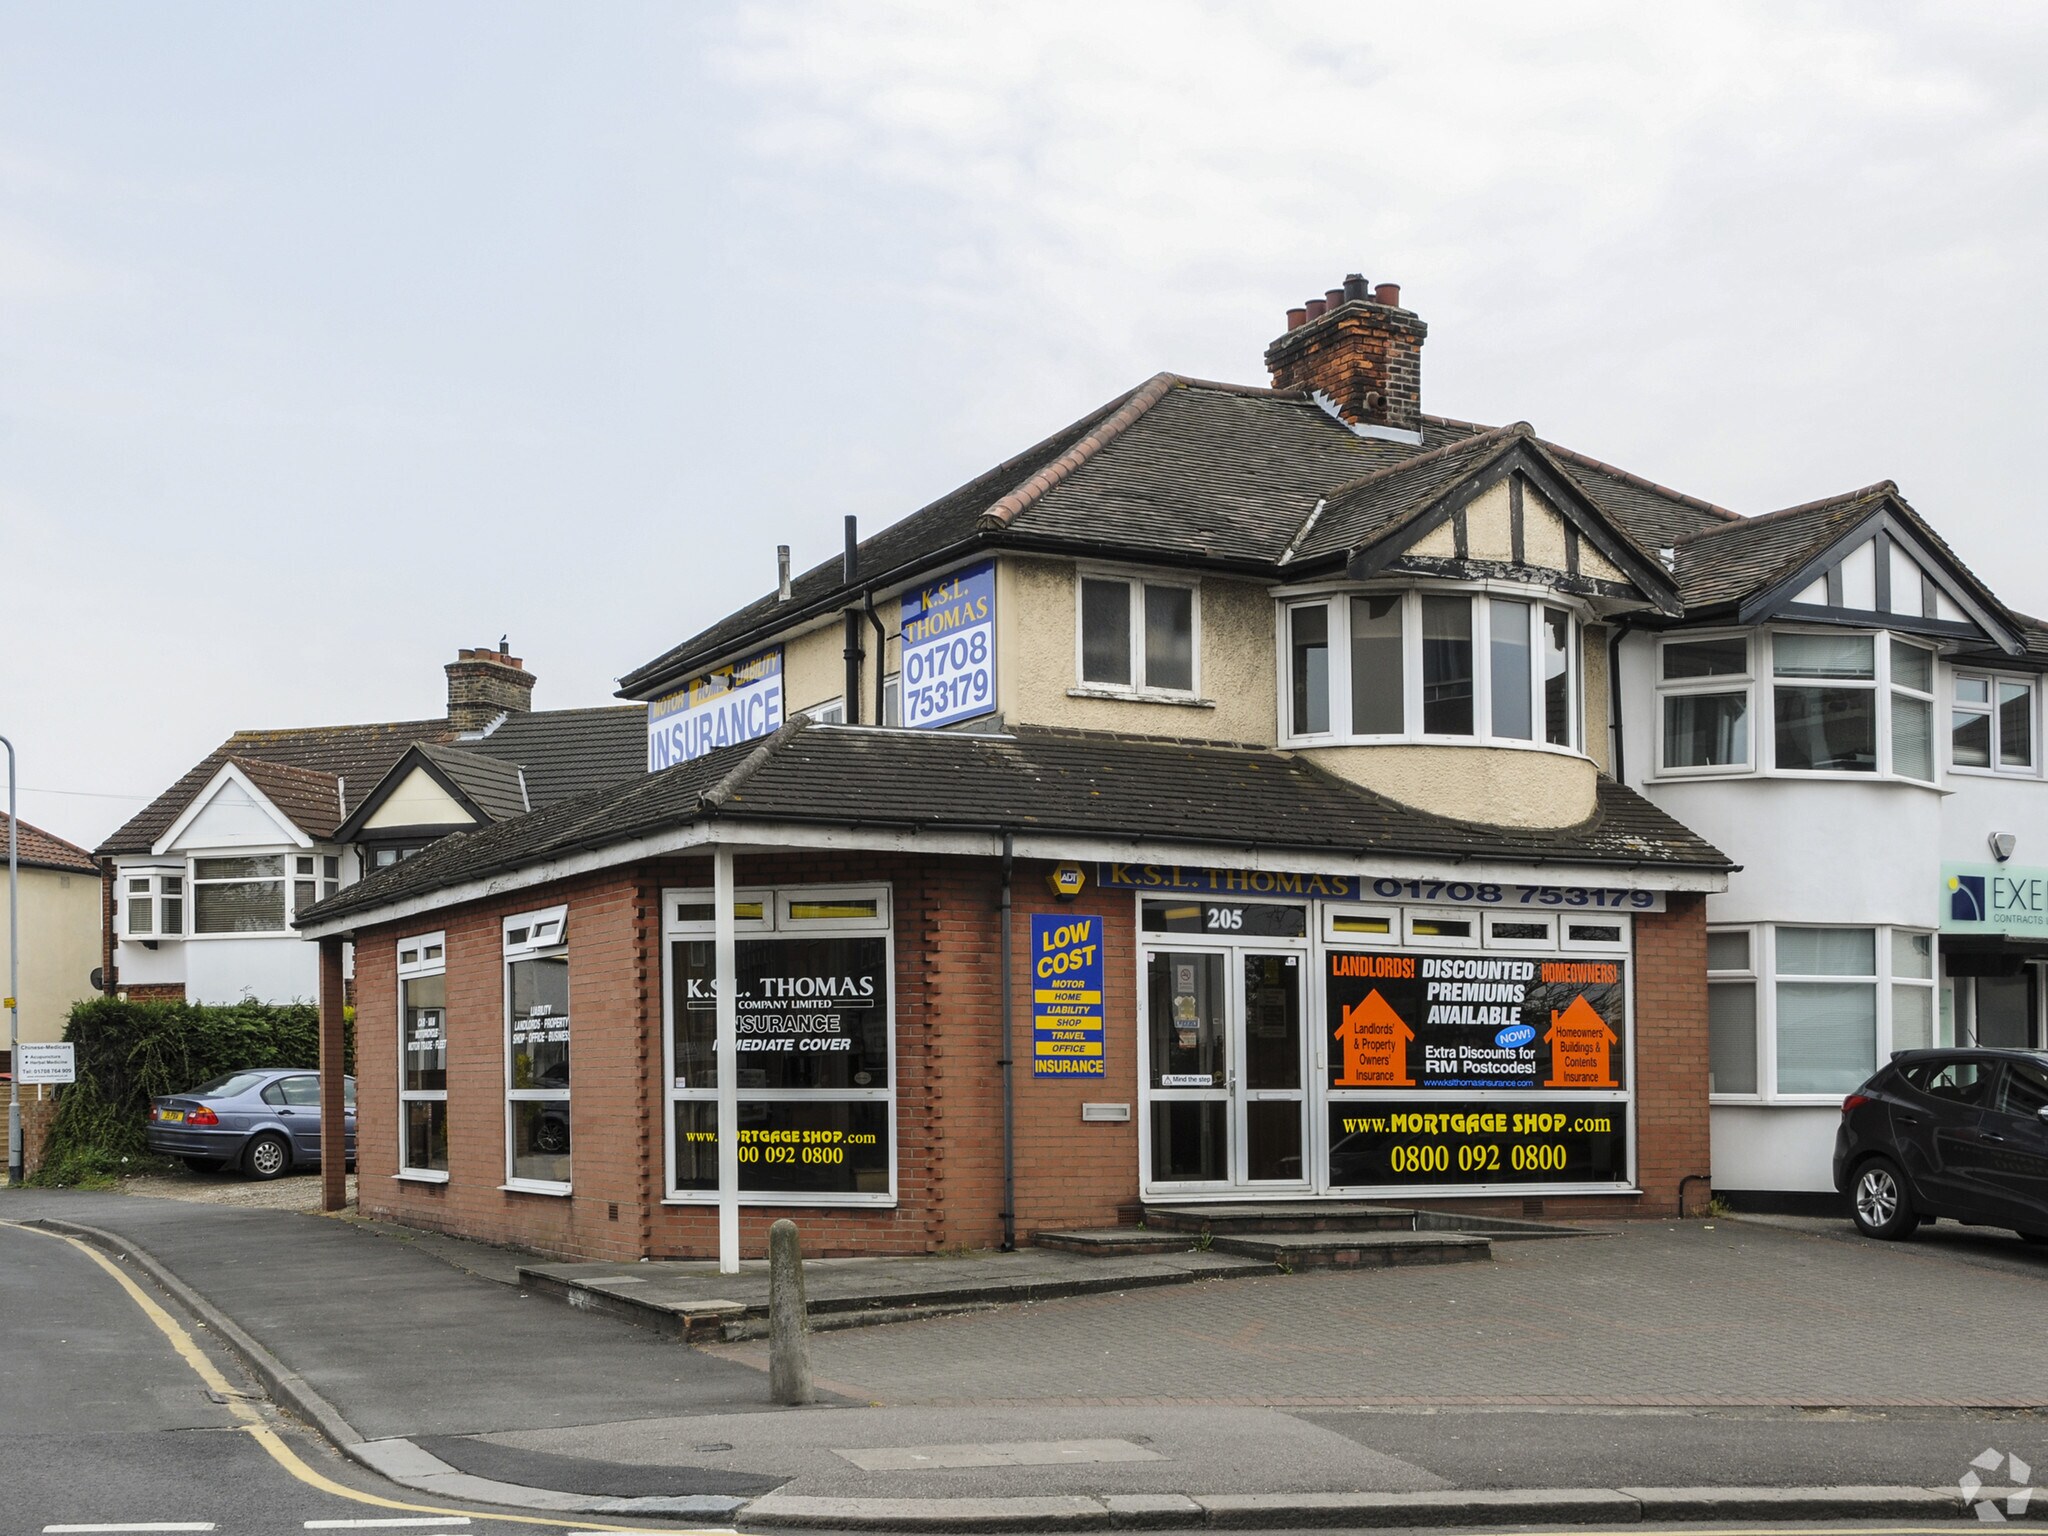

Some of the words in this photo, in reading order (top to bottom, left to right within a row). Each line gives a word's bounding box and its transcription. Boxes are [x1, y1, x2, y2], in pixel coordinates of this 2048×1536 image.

[922, 578, 969, 611] K.S.L.
[905, 596, 988, 644] THOMAS
[907, 630, 987, 685] 01708
[652, 690, 685, 718] MOTOR
[735, 650, 778, 687] LIABILITY
[907, 668, 989, 721] 753179
[650, 686, 780, 771] INSURANCE
[1061, 872, 1078, 882] ADT
[1112, 863, 1198, 889] K.S.L.
[1202, 868, 1350, 896] THOMAS
[1372, 877, 1503, 904] 01708
[1515, 885, 1654, 909] 753179
[1993, 877, 2048, 911] EXE
[1207, 907, 1244, 930] 205
[1993, 913, 2044, 925] CONTRACTS
[1043, 920, 1091, 952] LOW
[1037, 944, 1096, 978] COST
[1333, 955, 1415, 978] LANDLORDS!
[1422, 959, 1535, 980] DISCOUNTED
[1541, 963, 1617, 984] HOMEOWNERS!
[759, 976, 874, 997] THOMAS
[1052, 979, 1085, 988] MOTOR
[1054, 993, 1082, 1001] HOME
[1427, 982, 1526, 1003] PREMIUMS
[738, 1000, 788, 1010] COMPANY
[791, 1000, 832, 1009] LIMITED
[1047, 1006, 1090, 1014] LIABILITY
[1427, 1005, 1522, 1025] AVAILABLE
[1056, 1019, 1082, 1027] SHOP
[1354, 1022, 1395, 1035] Landlords'
[1052, 1031, 1086, 1040] TRAVEL
[1500, 1028, 1531, 1044] NOW!
[799, 1038, 851, 1051] COVER
[1052, 1044, 1086, 1053] OFFICE
[1353, 1039, 1359, 1050] &
[1362, 1038, 1396, 1053] Property
[1425, 1045, 1457, 1059] Extra
[1459, 1046, 1516, 1059] Discounts
[1519, 1047, 1536, 1059] for
[1560, 1041, 1594, 1055] Buildings
[1595, 1042, 1601, 1053] &
[1035, 1060, 1104, 1073] INSURANCE
[1359, 1053, 1391, 1066] Owners'
[1425, 1060, 1458, 1073] RM
[1463, 1061, 1536, 1074] Postcodes!
[1564, 1056, 1598, 1068] Contents
[1356, 1069, 1394, 1081] Insurance
[1564, 1071, 1599, 1083] Insurance
[765, 1146, 795, 1163] 092
[801, 1147, 843, 1164] 0800
[1391, 1145, 1449, 1172] 0800
[1458, 1144, 1500, 1171] 092
[1511, 1144, 1567, 1171] 0800
